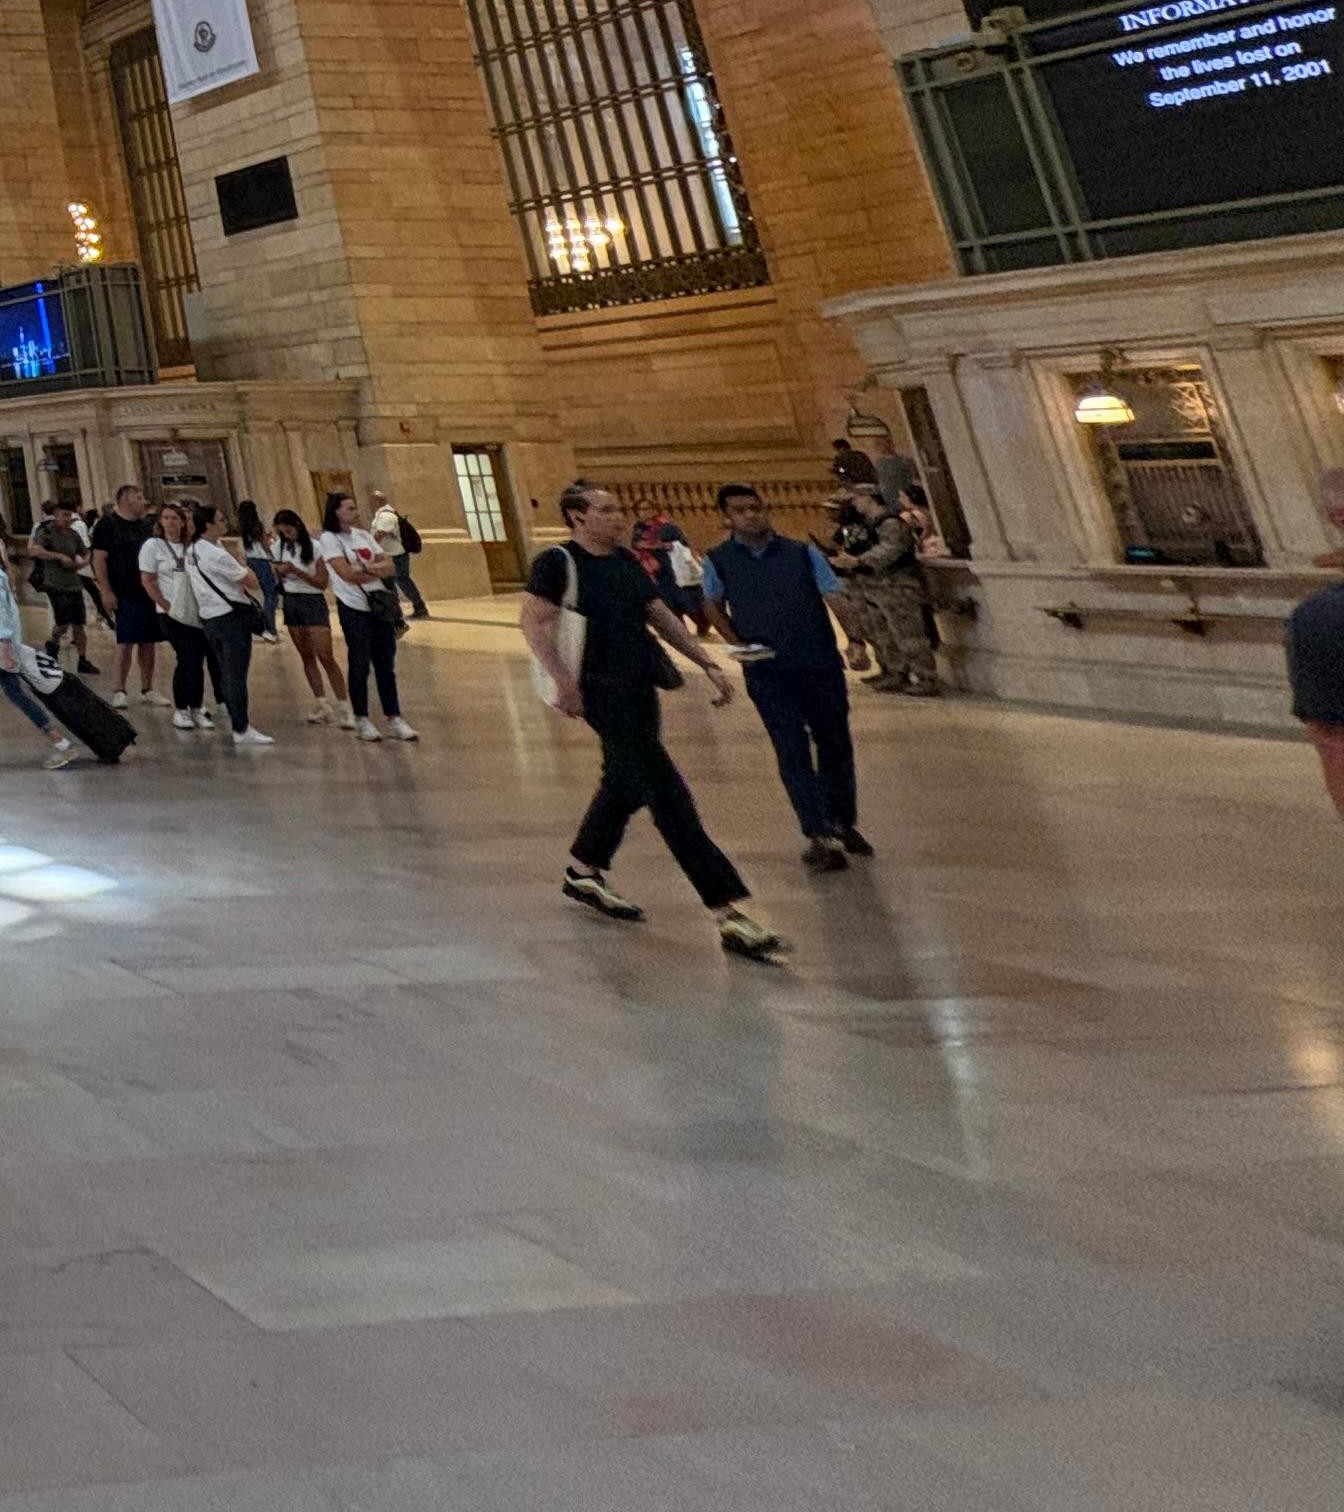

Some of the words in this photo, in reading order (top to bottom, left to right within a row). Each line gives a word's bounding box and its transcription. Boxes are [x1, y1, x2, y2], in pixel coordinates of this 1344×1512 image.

[1111, 48, 1145, 67] We
[1146, 29, 1237, 61] remember
[1238, 18, 1277, 39] and
[1276, 7, 1336, 32] honor
[1159, 64, 1191, 81] the
[1190, 54, 1236, 75] lives
[1235, 45, 1274, 65] lost
[1273, 41, 1303, 58] on
[1148, 78, 1247, 108] September
[1248, 70, 1282, 88] 11,
[1280, 58, 1332, 82] 2001
